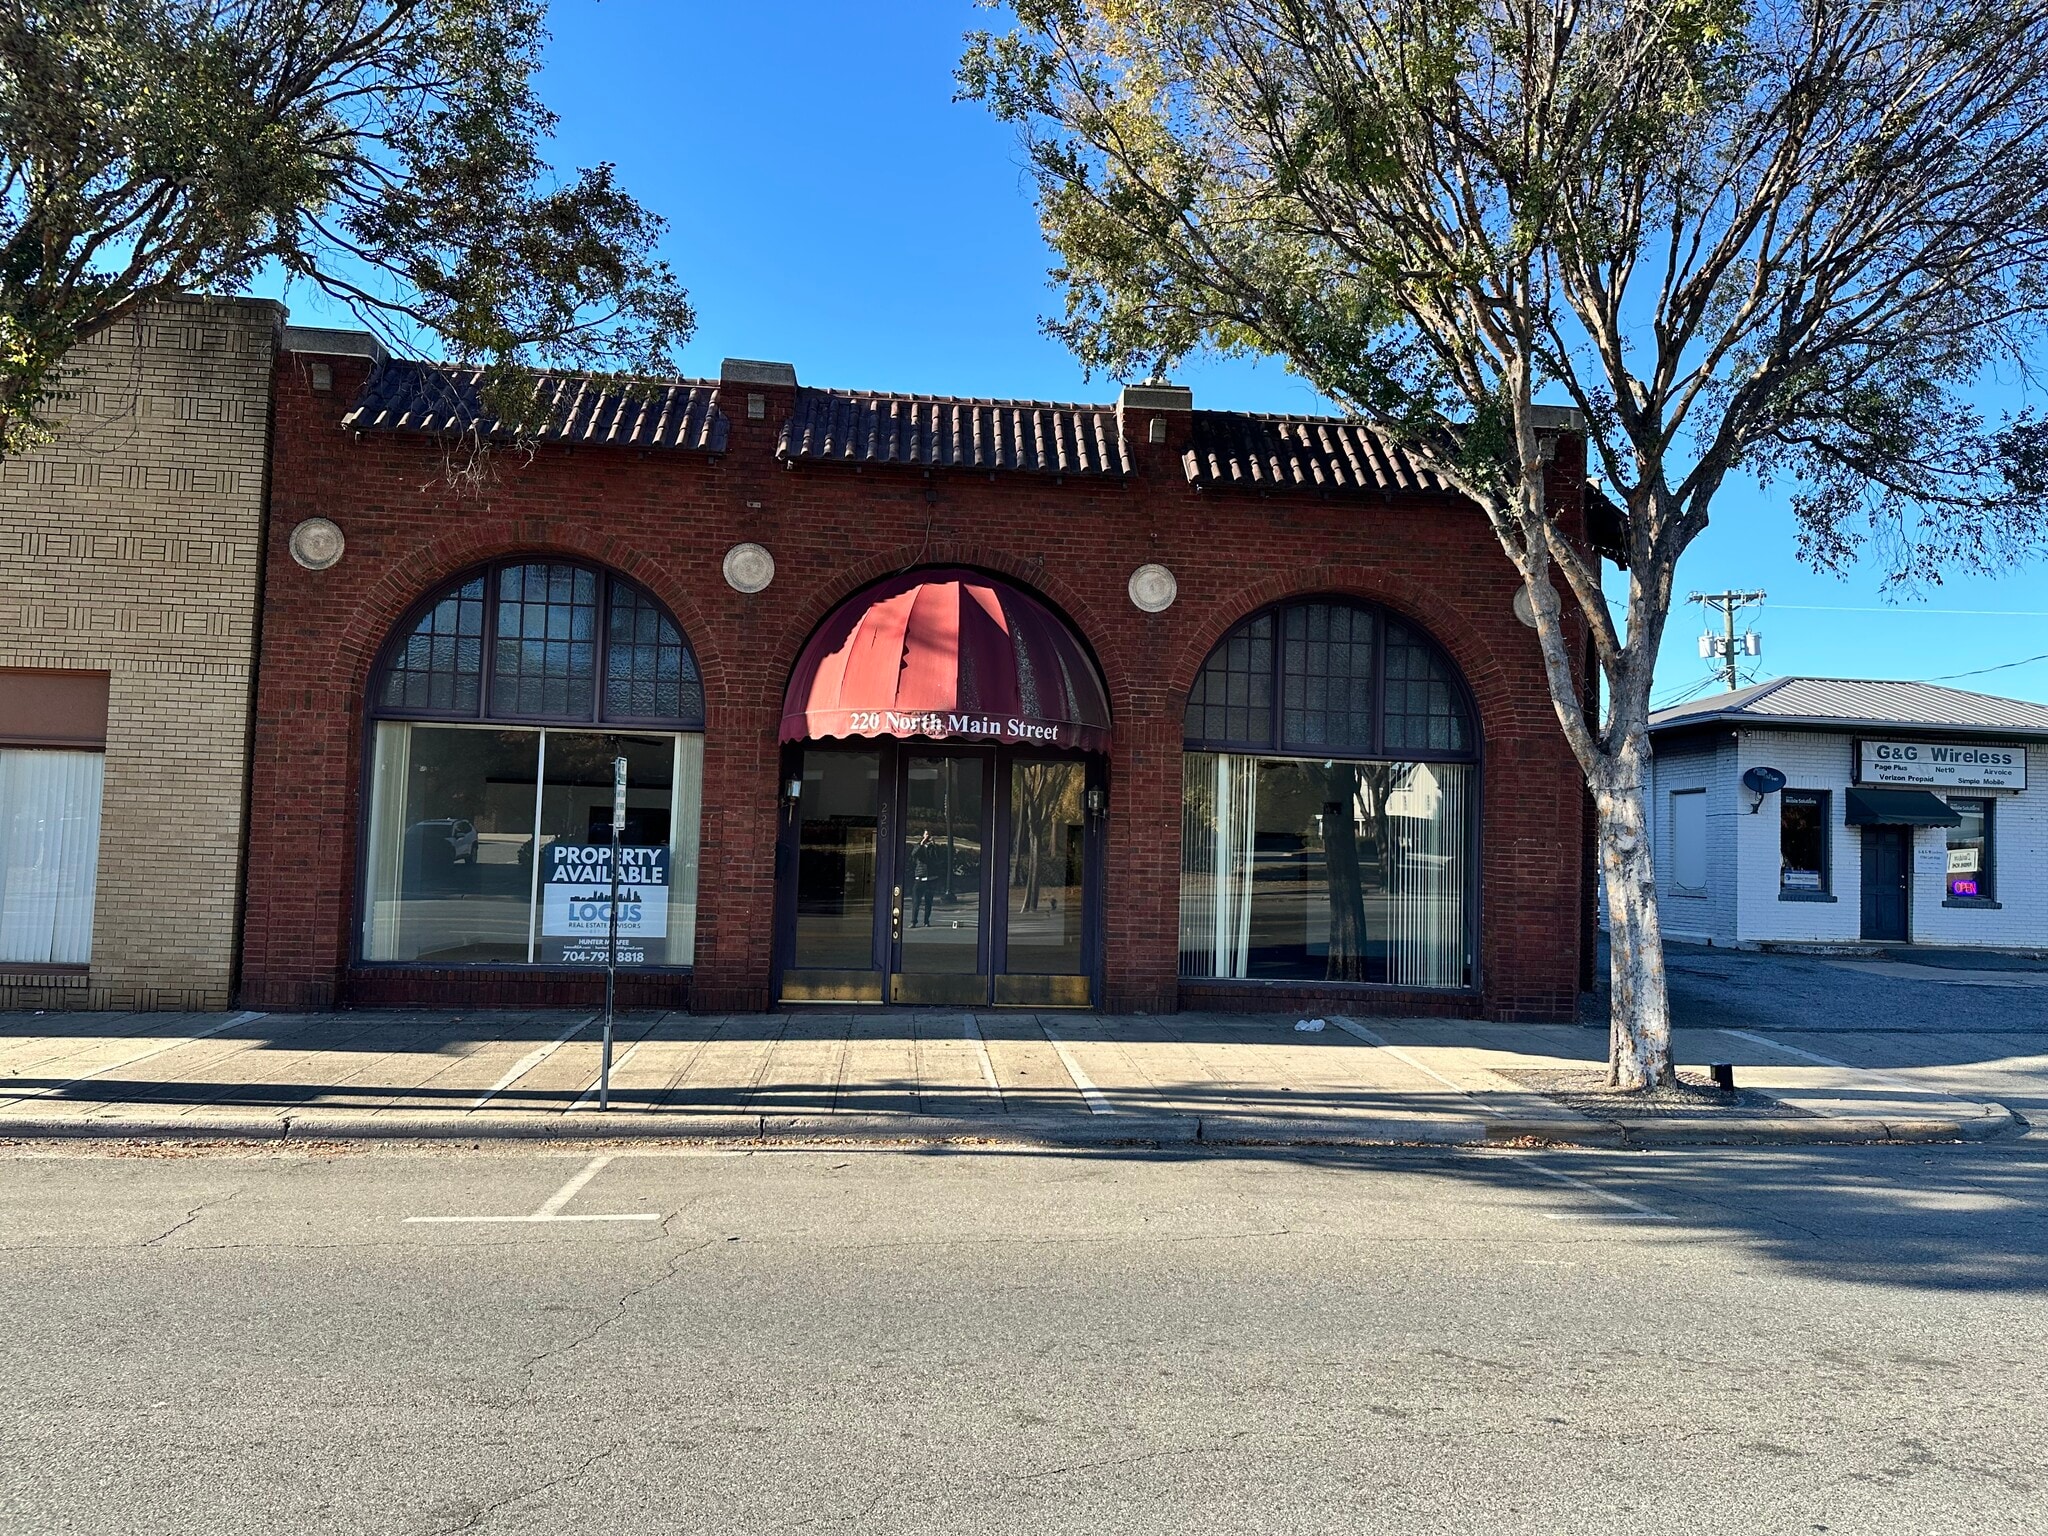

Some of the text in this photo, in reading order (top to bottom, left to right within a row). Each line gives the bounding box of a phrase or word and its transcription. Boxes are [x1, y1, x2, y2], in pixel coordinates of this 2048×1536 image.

[850, 711, 1059, 741] 220 North Main Street
[1876, 744, 2012, 765] G&G Wireless
[1874, 763, 2012, 776] Page Plus Net10 Airvoice
[1879, 773, 2005, 786] Verizon Prepaid Simple Mobile
[1954, 881, 1977, 895] OPEN
